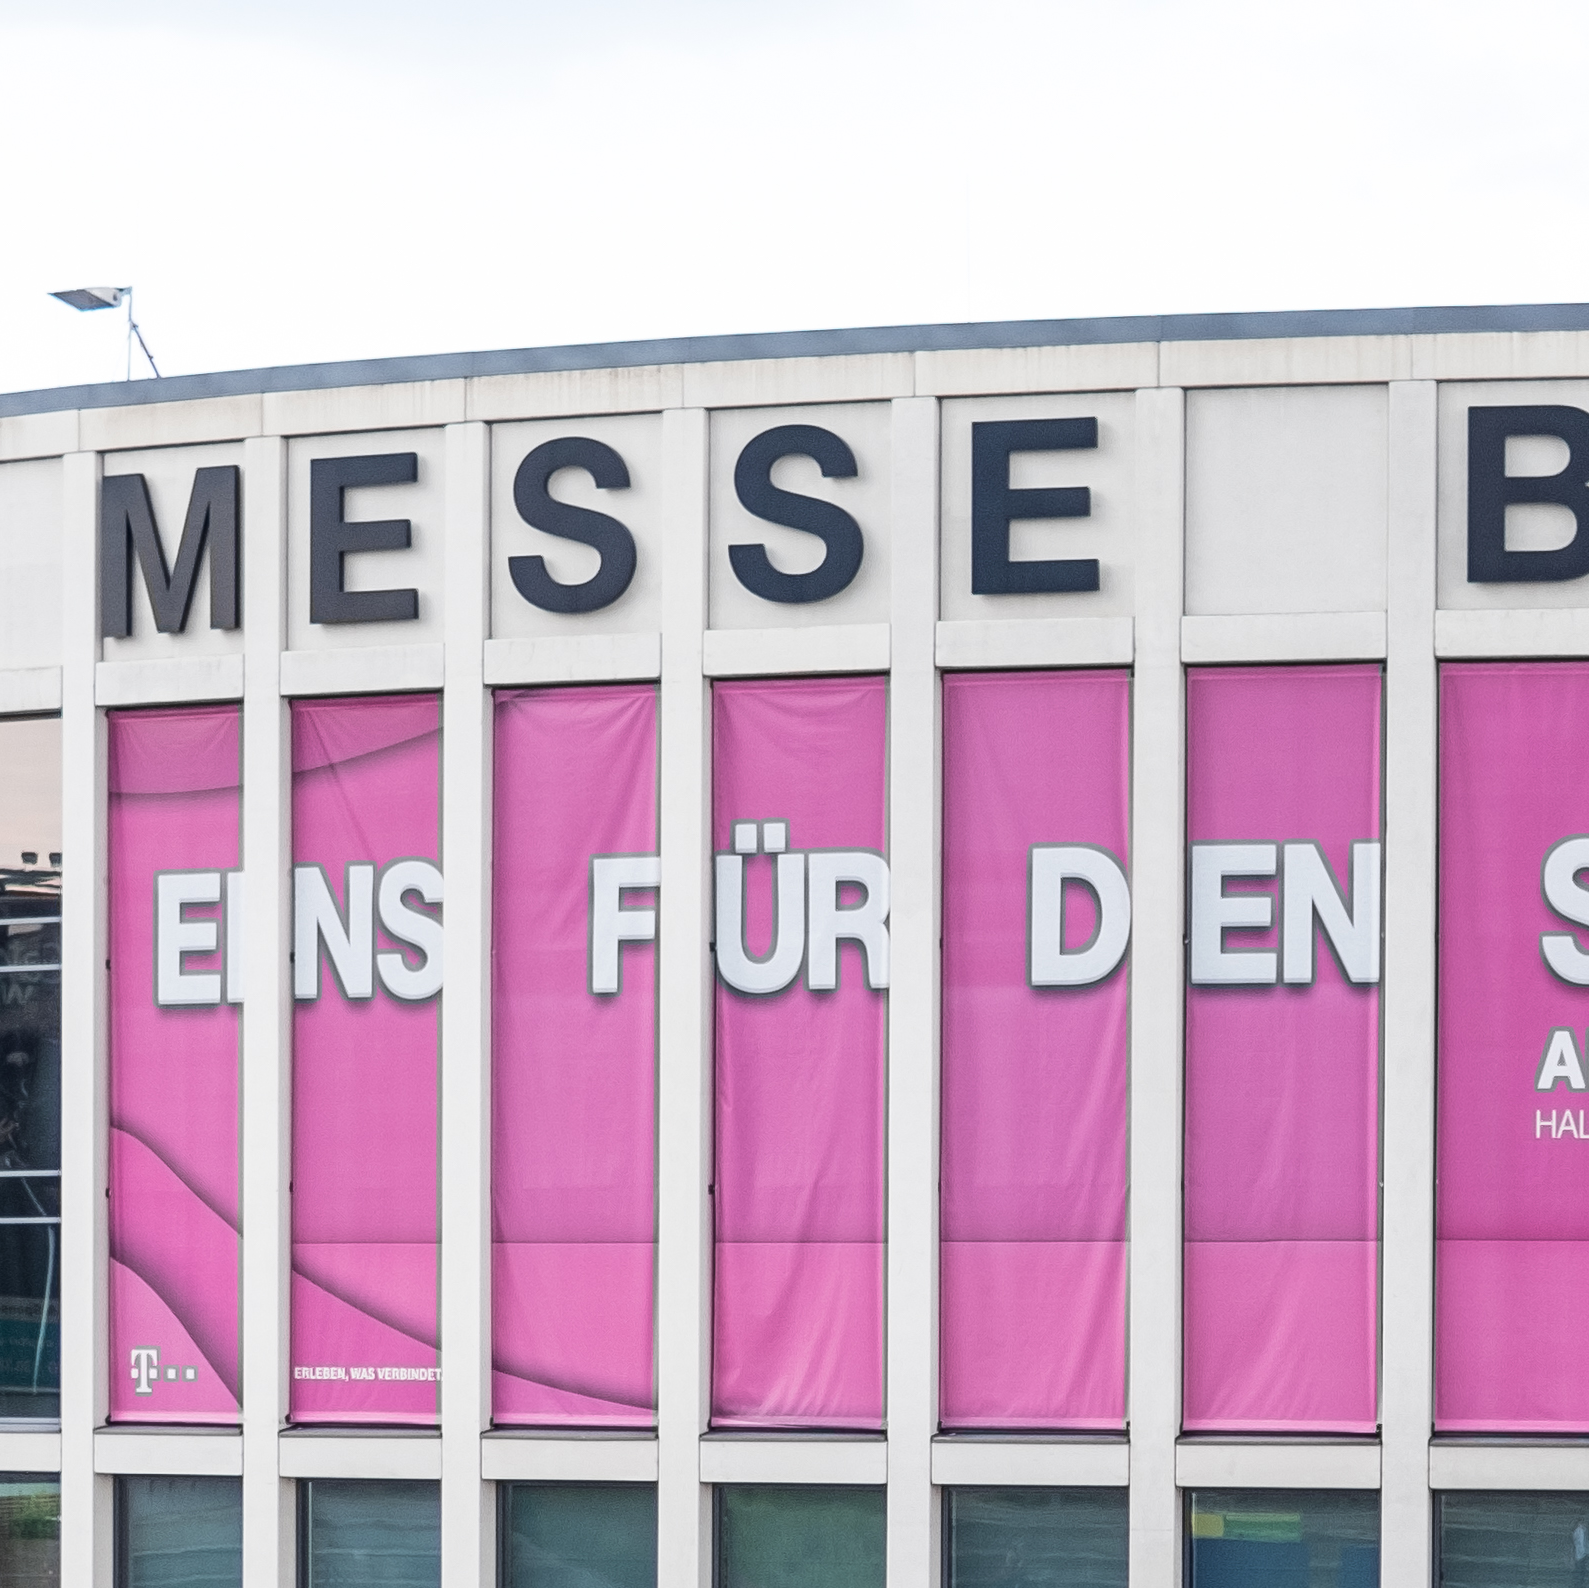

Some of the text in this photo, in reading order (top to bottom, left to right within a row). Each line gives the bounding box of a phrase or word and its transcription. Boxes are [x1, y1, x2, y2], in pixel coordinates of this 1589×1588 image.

[101, 416, 1100, 639] MESSE
[156, 860, 444, 1005] EINS
[591, 821, 892, 994] FÜR
[1029, 841, 1381, 986] DEN
[294, 1366, 349, 1382] ERLEBEN,
[350, 1367, 375, 1380] WAS
